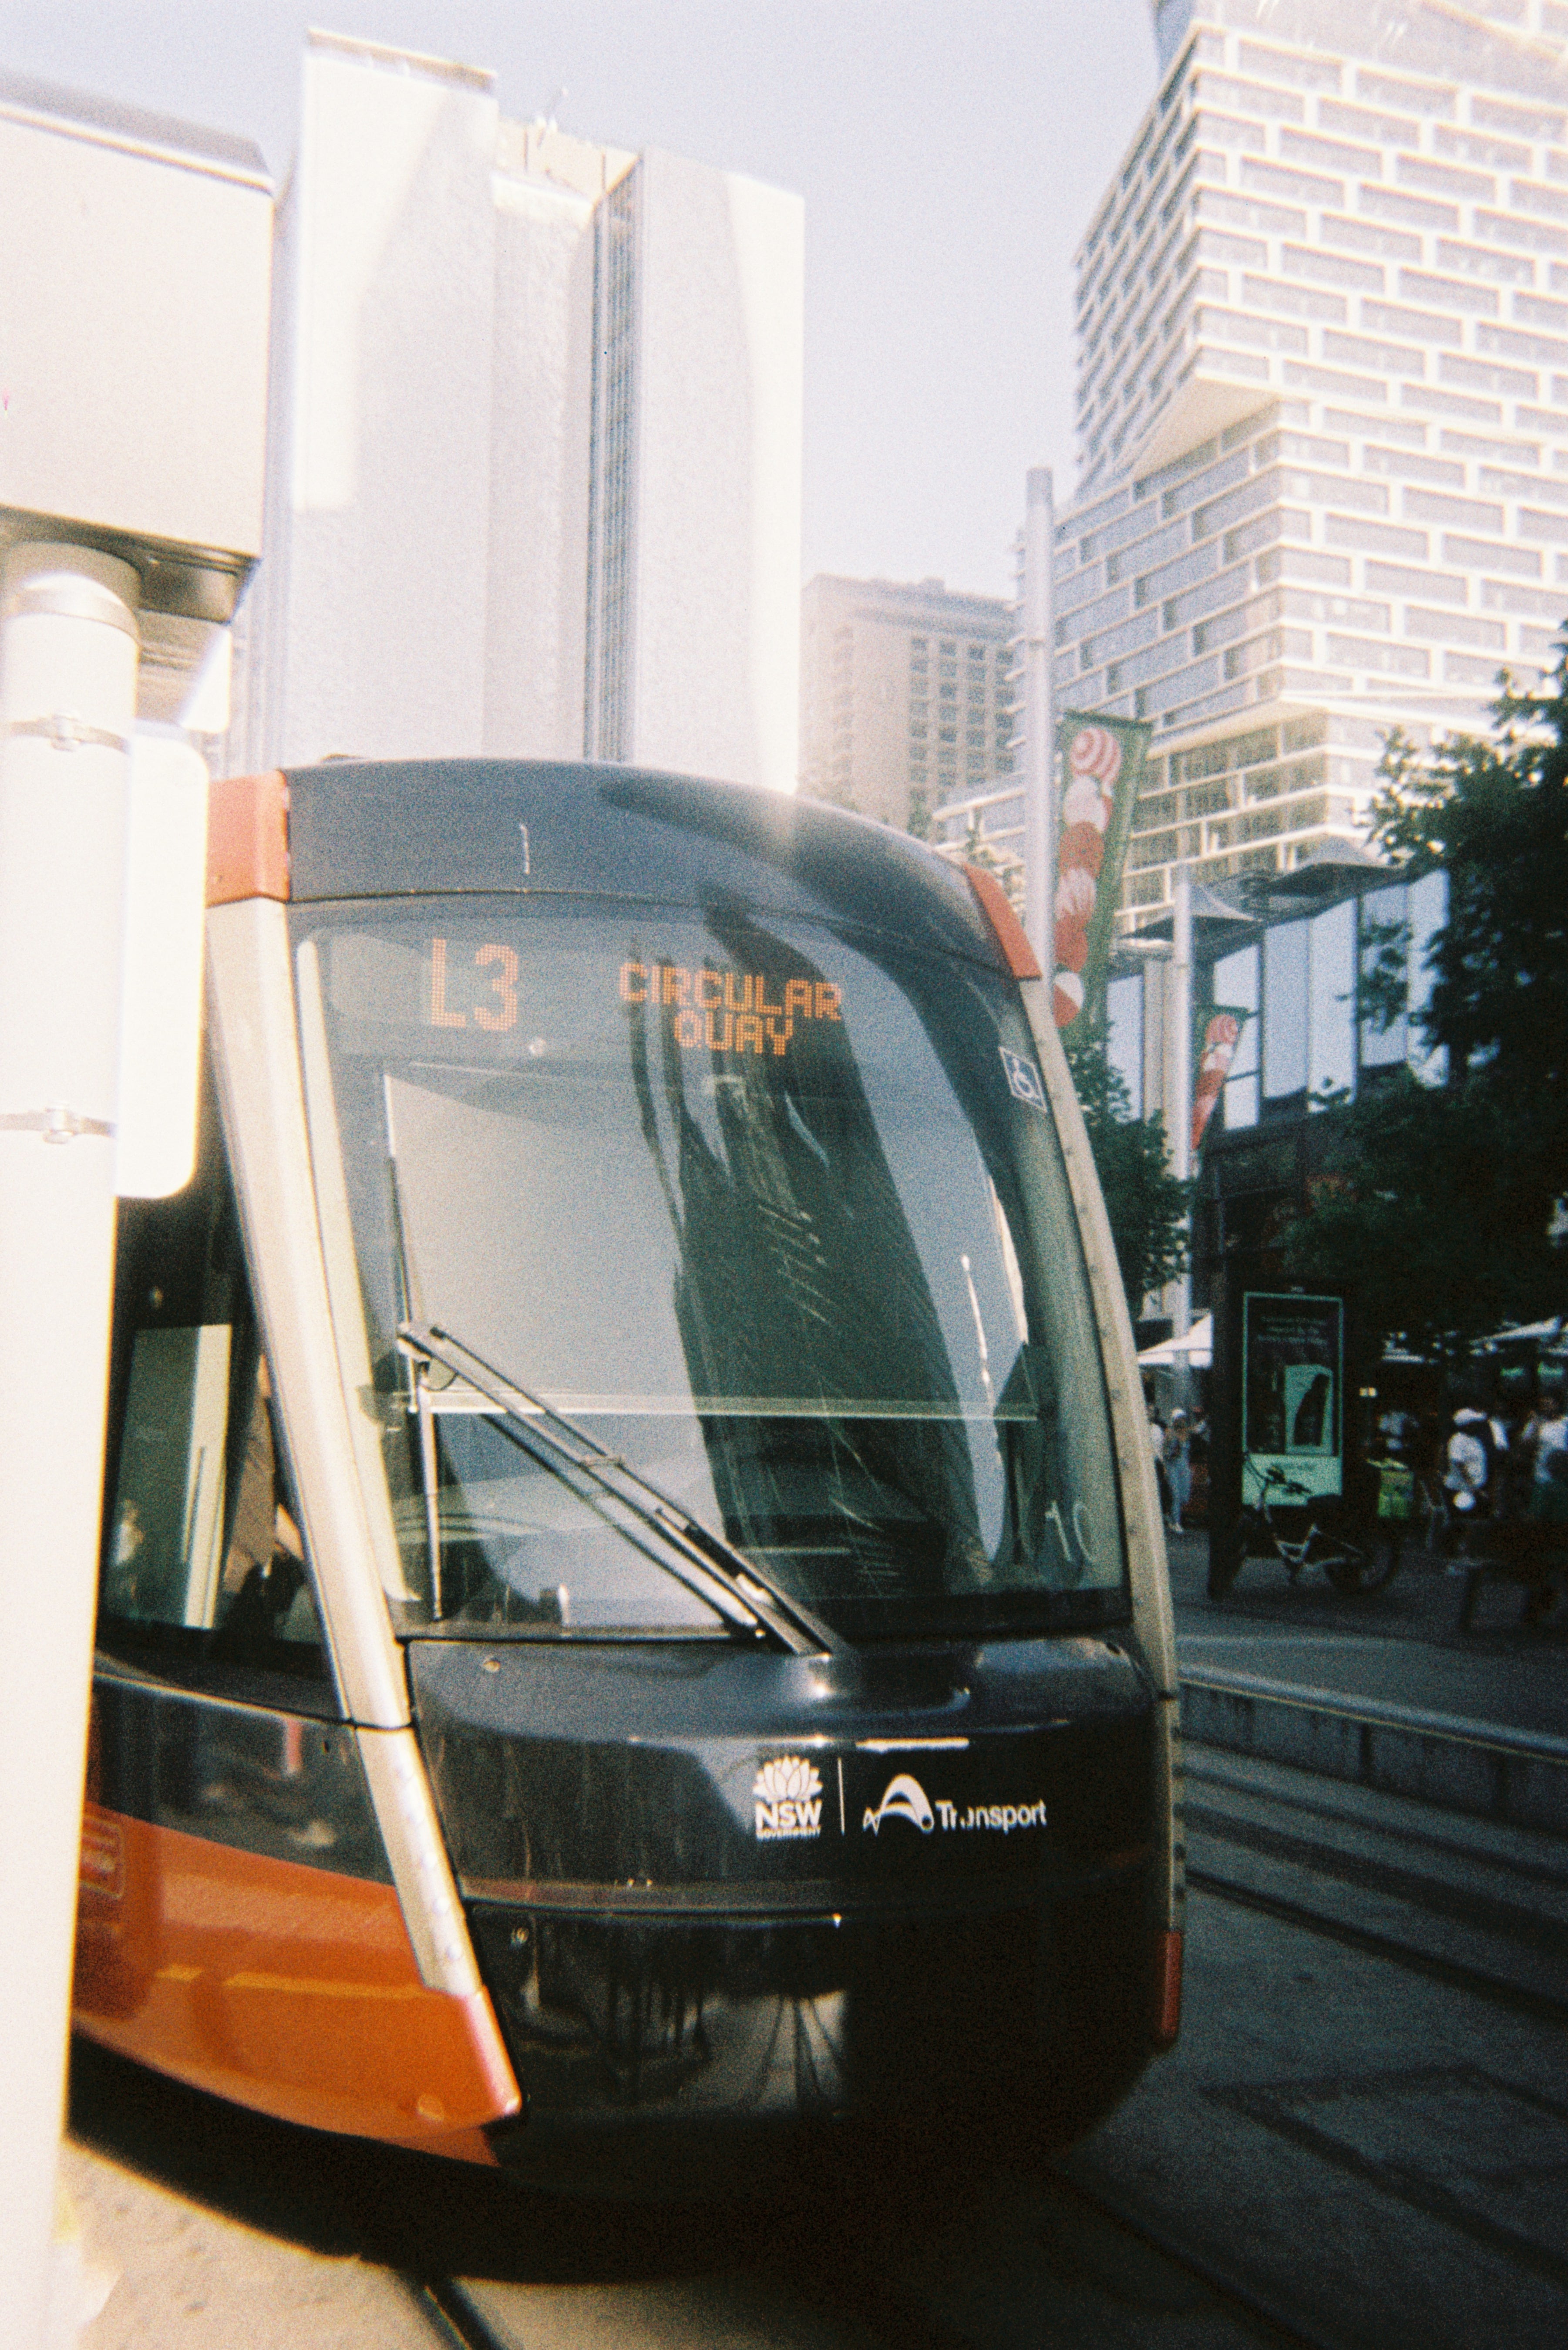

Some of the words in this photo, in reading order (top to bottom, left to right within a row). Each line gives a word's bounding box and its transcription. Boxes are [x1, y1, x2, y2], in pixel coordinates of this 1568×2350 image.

[431, 939, 518, 1031] L3
[620, 962, 842, 1021] CIRCULAR
[673, 1010, 793, 1056] QUAY
[755, 1799, 822, 1829] NSW
